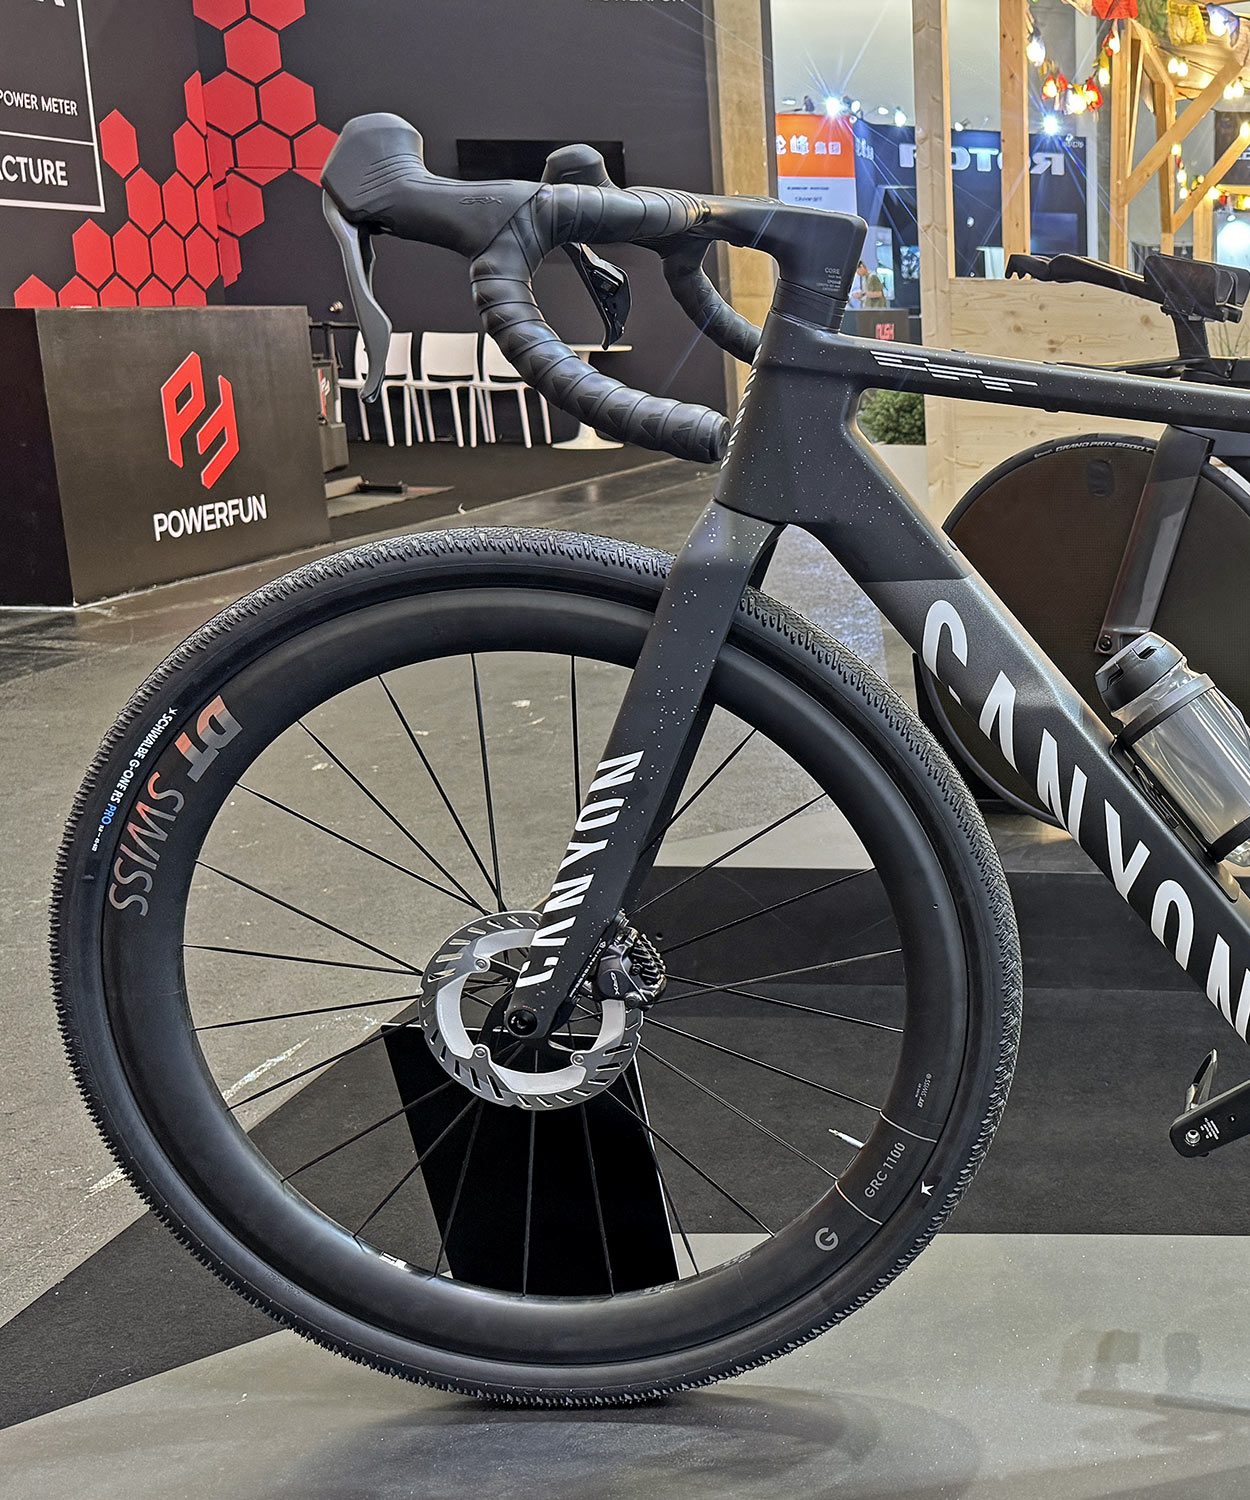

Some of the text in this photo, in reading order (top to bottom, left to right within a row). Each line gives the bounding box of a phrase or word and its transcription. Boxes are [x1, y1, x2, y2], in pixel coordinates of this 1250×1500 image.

[41, 95, 78, 116] METER
[0, 154, 69, 187] CTURE
[1055, 441, 1089, 453] GRAND
[1115, 442, 1144, 451] 5000
[153, 494, 268, 542] POWERFUN
[101, 713, 173, 826] SCHWALBE G-ONE RS PRO
[108, 695, 243, 917] DT SWISS
[515, 750, 644, 988] CANYON
[610, 971, 620, 996] GRX
[917, 1096, 925, 1109] DT
[864, 1142, 906, 1198] GRC 1100
[814, 1227, 839, 1251] G
